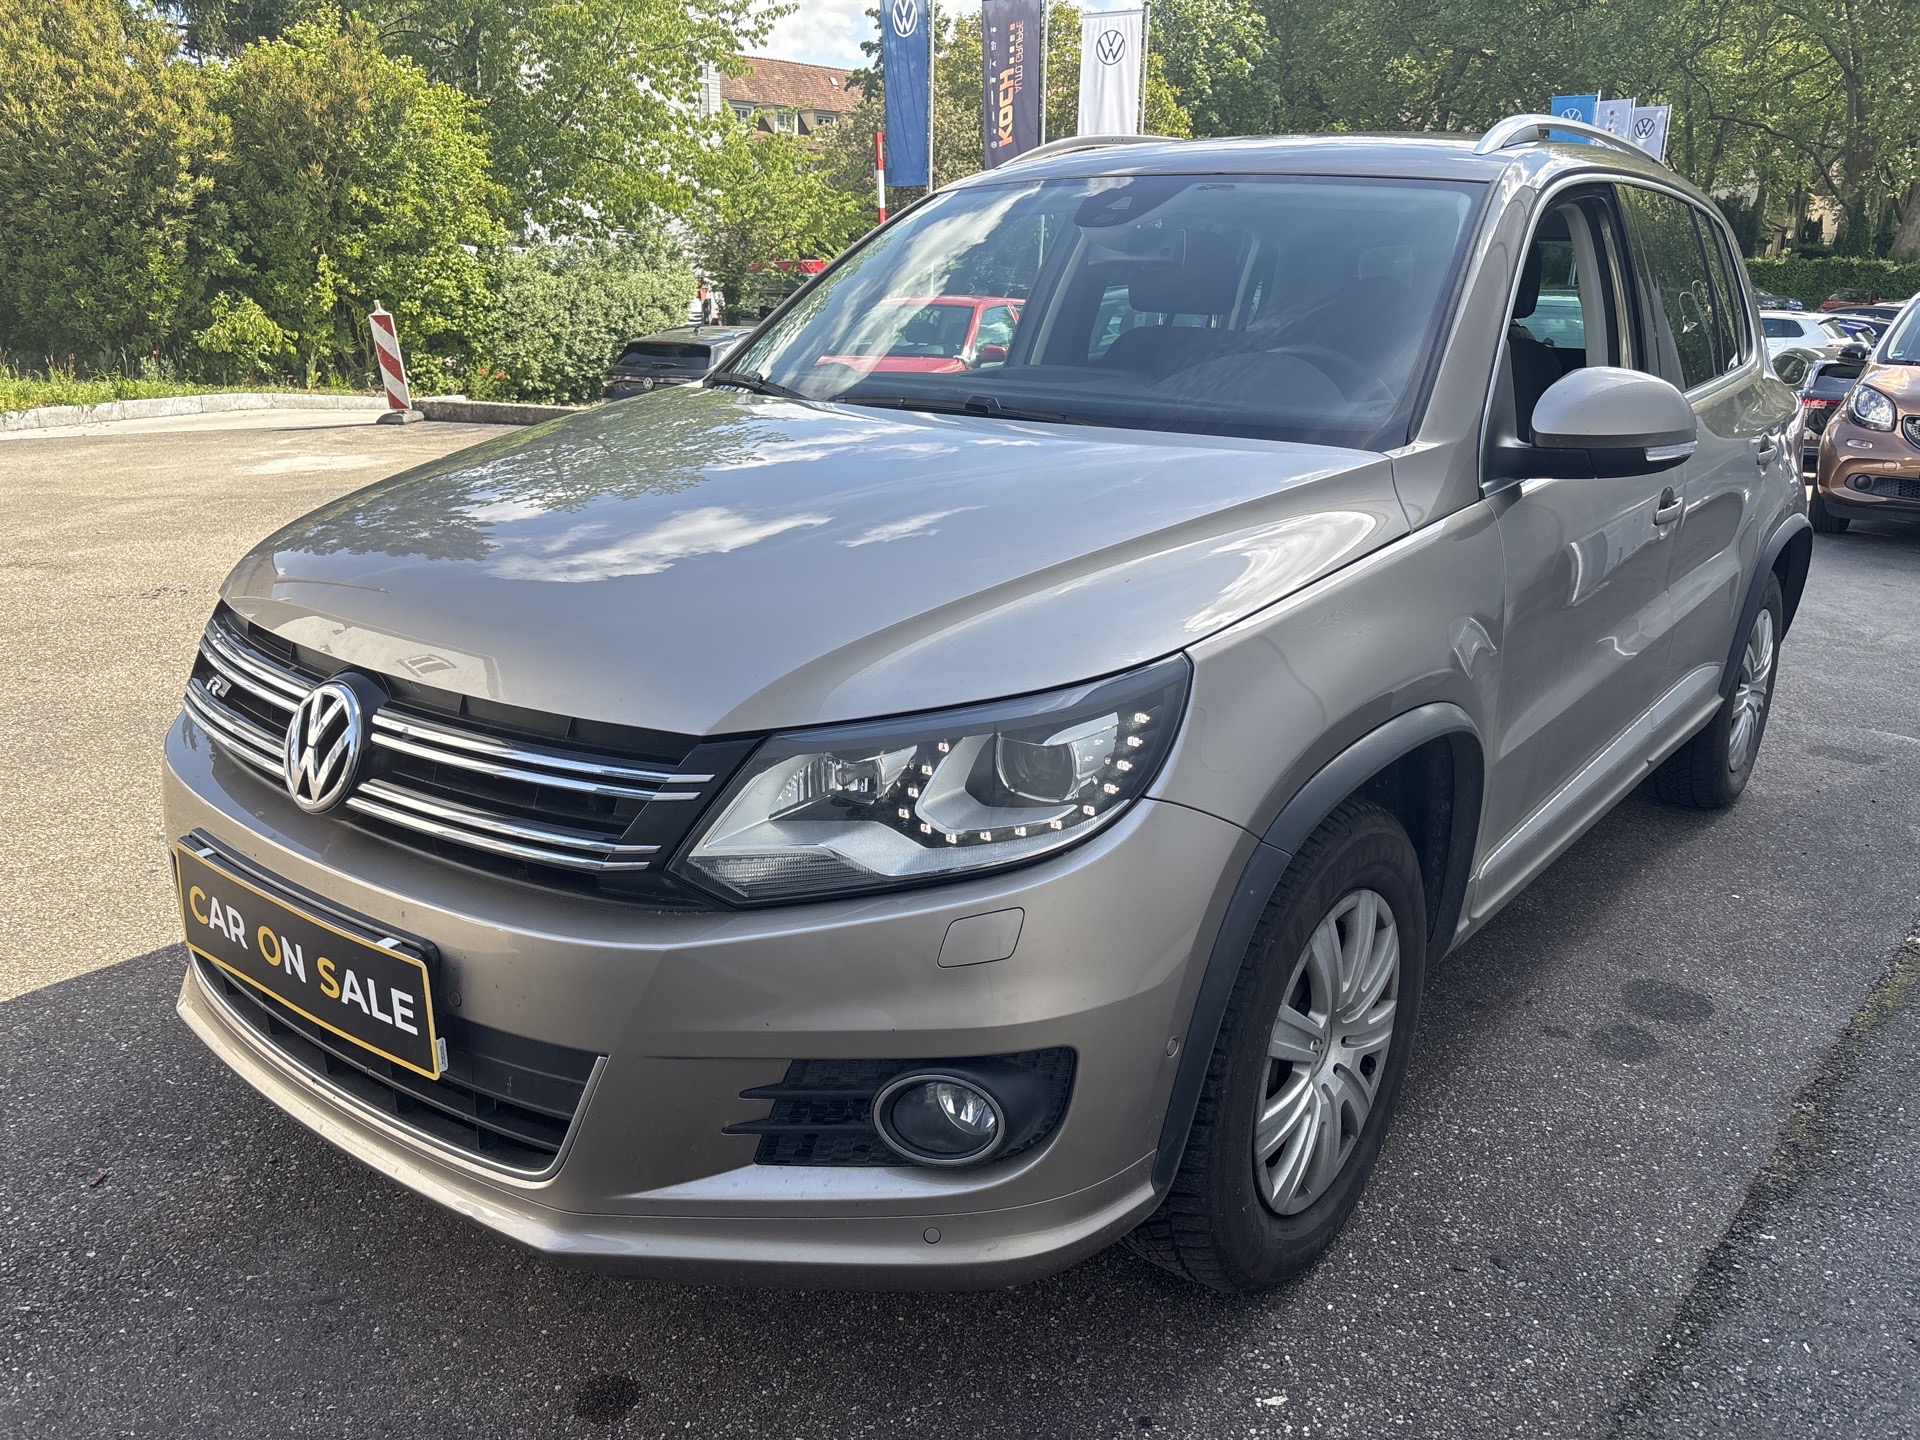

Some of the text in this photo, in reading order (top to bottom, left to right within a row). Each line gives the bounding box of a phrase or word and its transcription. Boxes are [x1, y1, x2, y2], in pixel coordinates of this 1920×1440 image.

[190, 885, 419, 1036] CAR ON SALE
